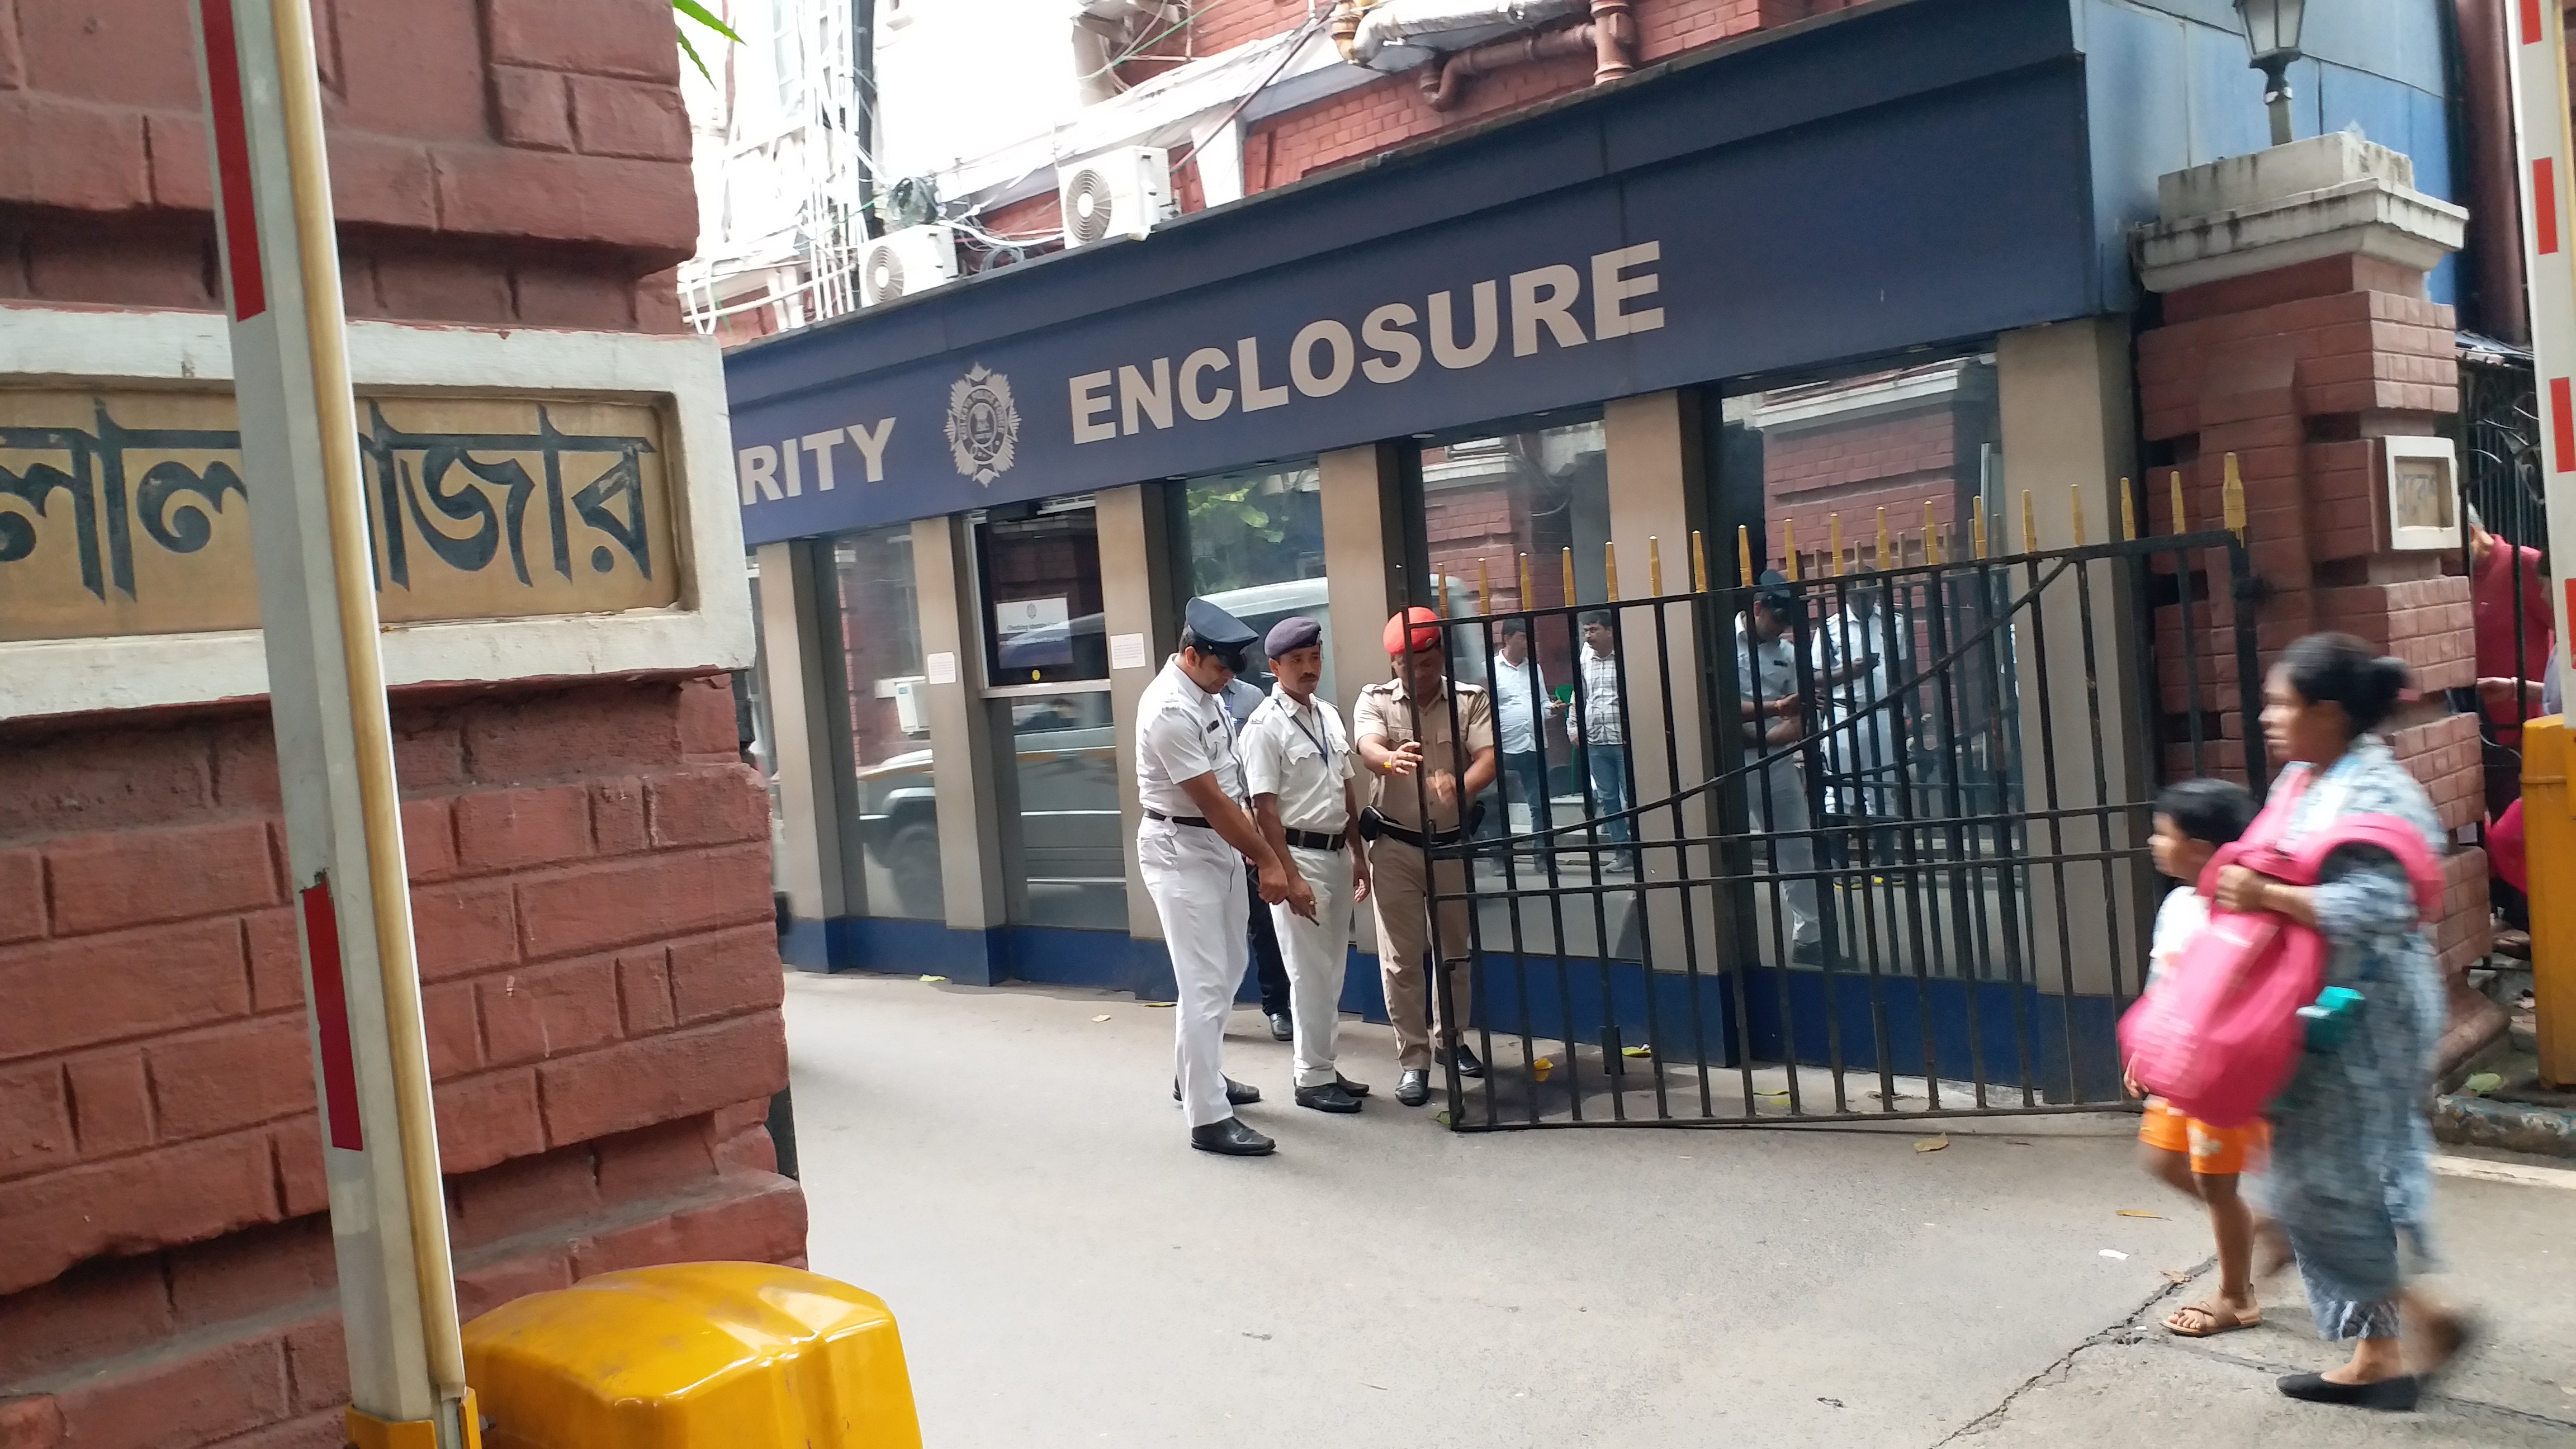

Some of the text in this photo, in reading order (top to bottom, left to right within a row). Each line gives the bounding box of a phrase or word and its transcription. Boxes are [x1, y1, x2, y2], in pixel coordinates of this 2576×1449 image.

[738, 240, 1665, 506] RITY ENCLOSURE
[0, 397, 657, 605] লালাজার
